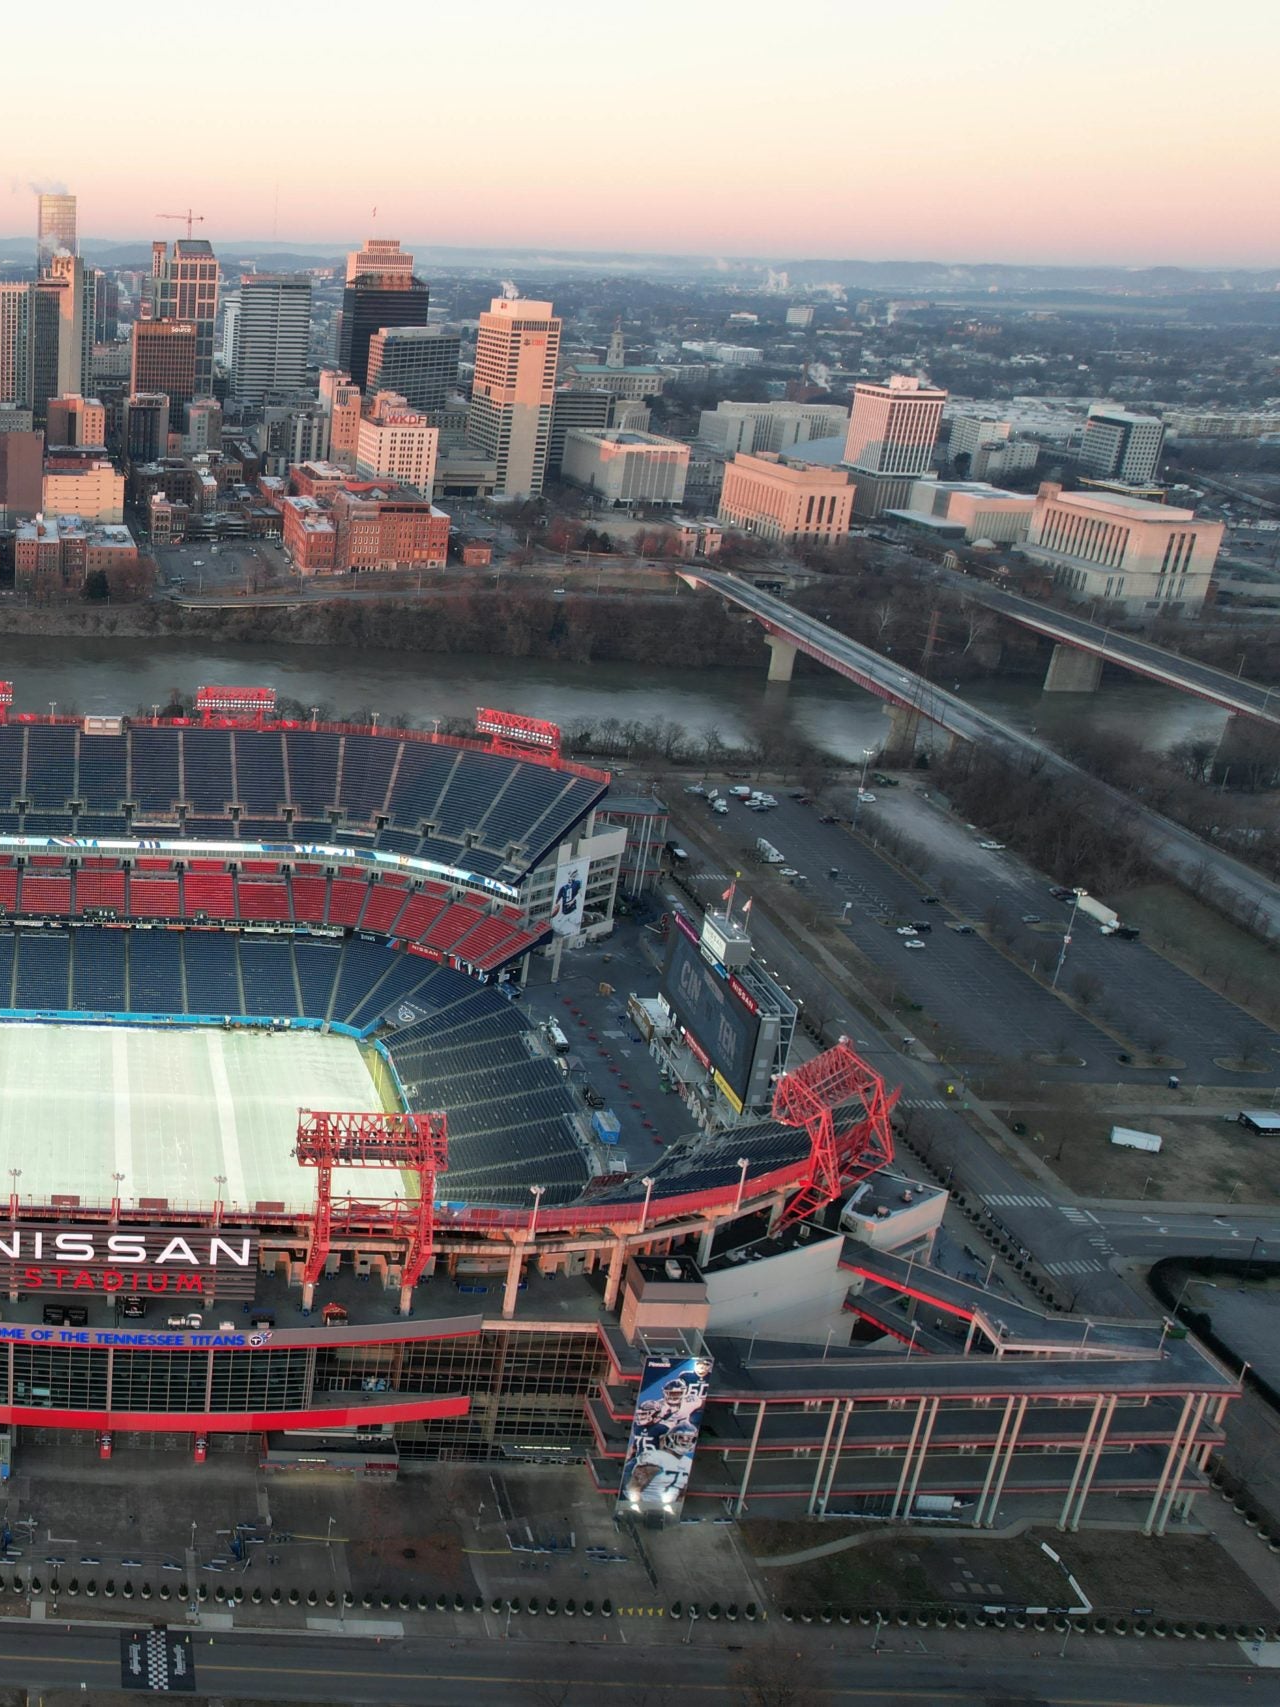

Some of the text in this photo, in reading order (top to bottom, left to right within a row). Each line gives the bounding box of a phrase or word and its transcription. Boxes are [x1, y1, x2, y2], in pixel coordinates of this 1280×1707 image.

[388, 414, 428, 425] WKDF
[411, 945, 439, 957] NISSAN
[681, 960, 702, 1003] CIN
[732, 981, 755, 1011] NISSAN
[23, 1267, 205, 1294] STADIUM
[30, 1328, 54, 1341] OF
[59, 1330, 90, 1343] THE
[95, 1332, 185, 1346] TENNESSEE
[189, 1334, 246, 1347] TITANS
